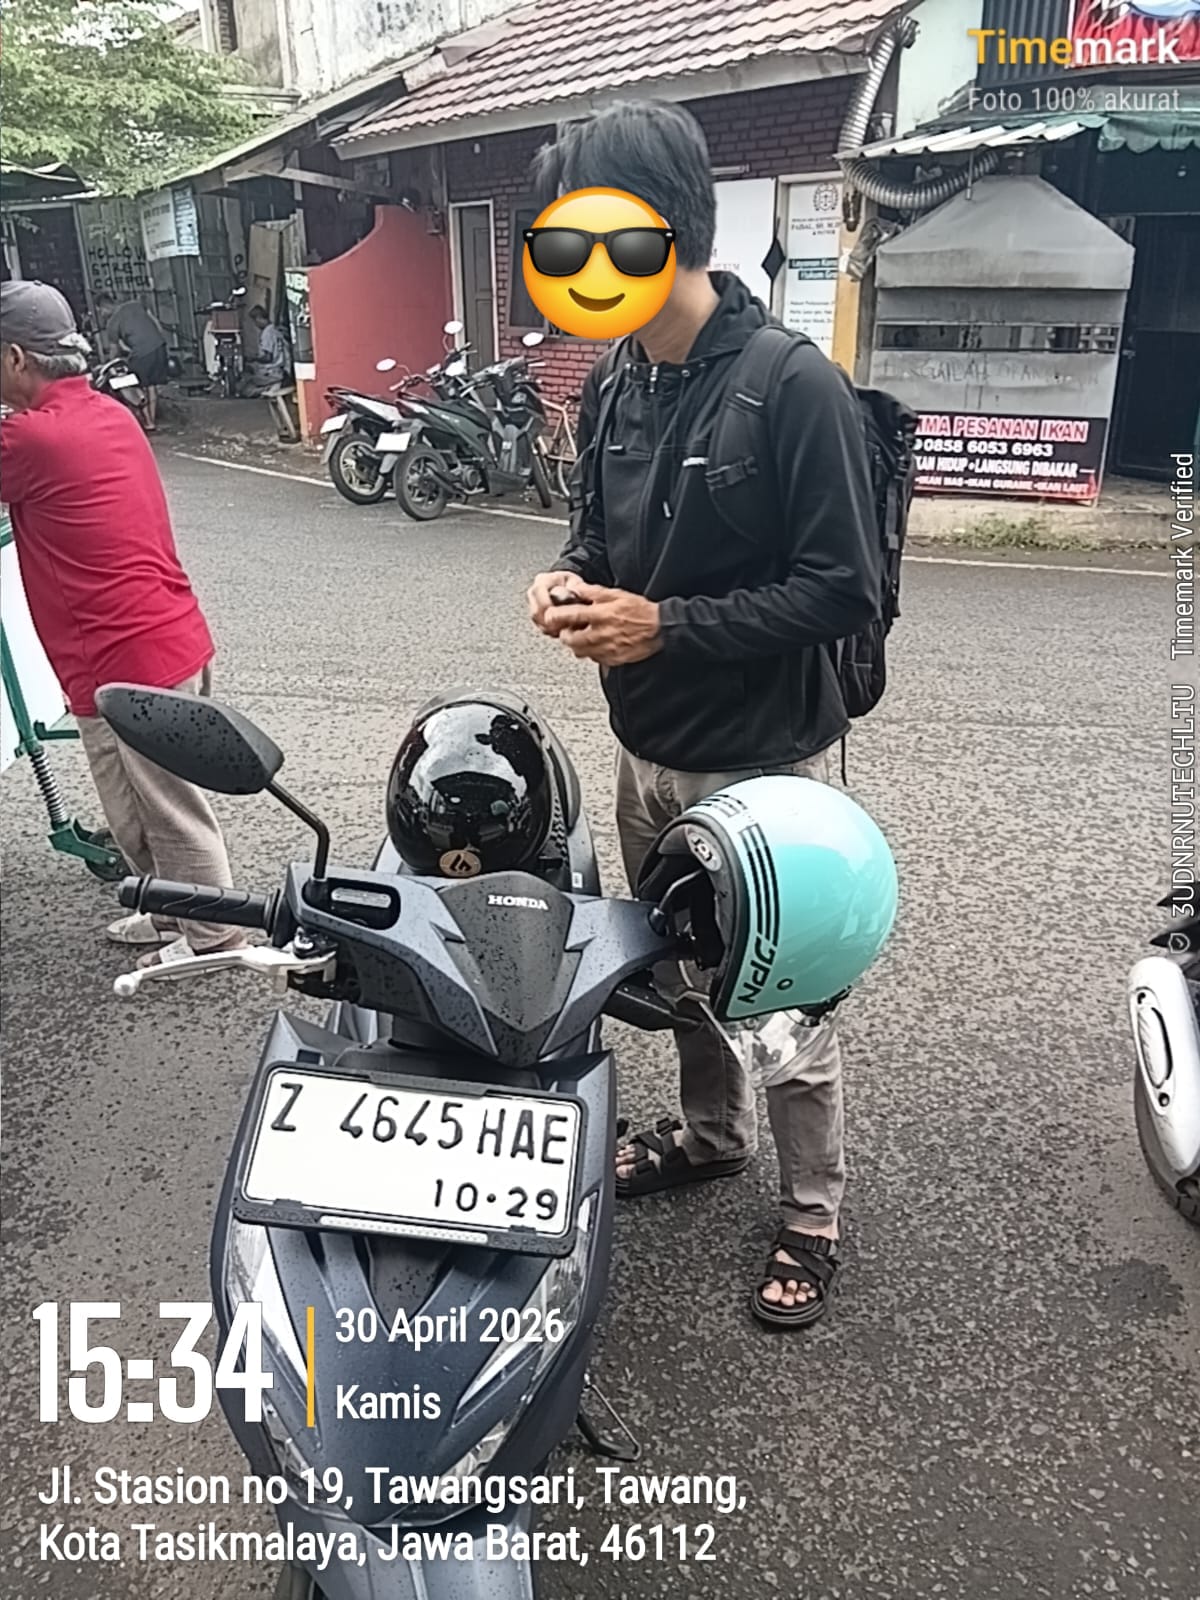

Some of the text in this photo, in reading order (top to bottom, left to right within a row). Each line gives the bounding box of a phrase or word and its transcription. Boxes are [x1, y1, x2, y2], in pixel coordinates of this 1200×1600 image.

[953, 417, 1038, 440] PESANAN
[1041, 421, 1088, 442] IKAN
[923, 439, 1053, 457] 0858 6053 6963
[1031, 461, 1078, 478] DIBAKAR
[487, 894, 549, 912] HONDA
[737, 935, 777, 1005] JPN
[270, 1082, 568, 1165] Z 4645 HAE
